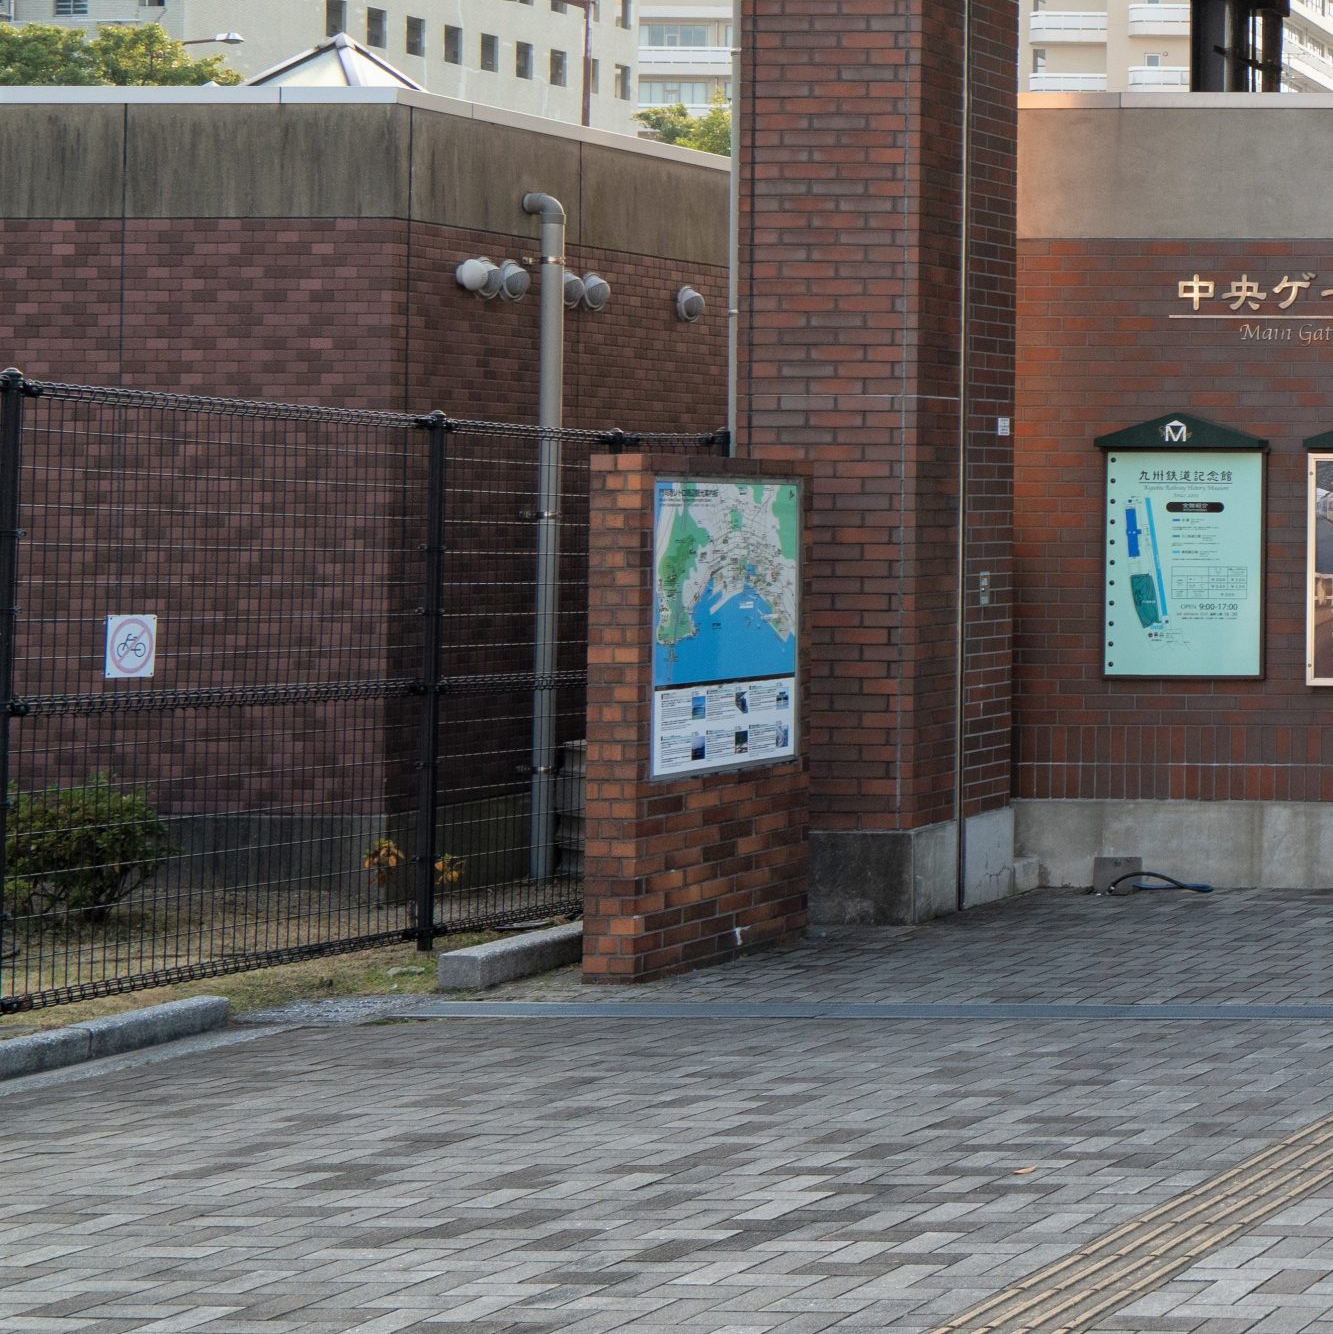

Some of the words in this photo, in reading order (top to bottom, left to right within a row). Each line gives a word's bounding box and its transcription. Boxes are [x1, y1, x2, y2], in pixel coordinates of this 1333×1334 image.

[1239, 323, 1292, 341] Main
[1139, 470, 1233, 482] 九州鉄道記念館
